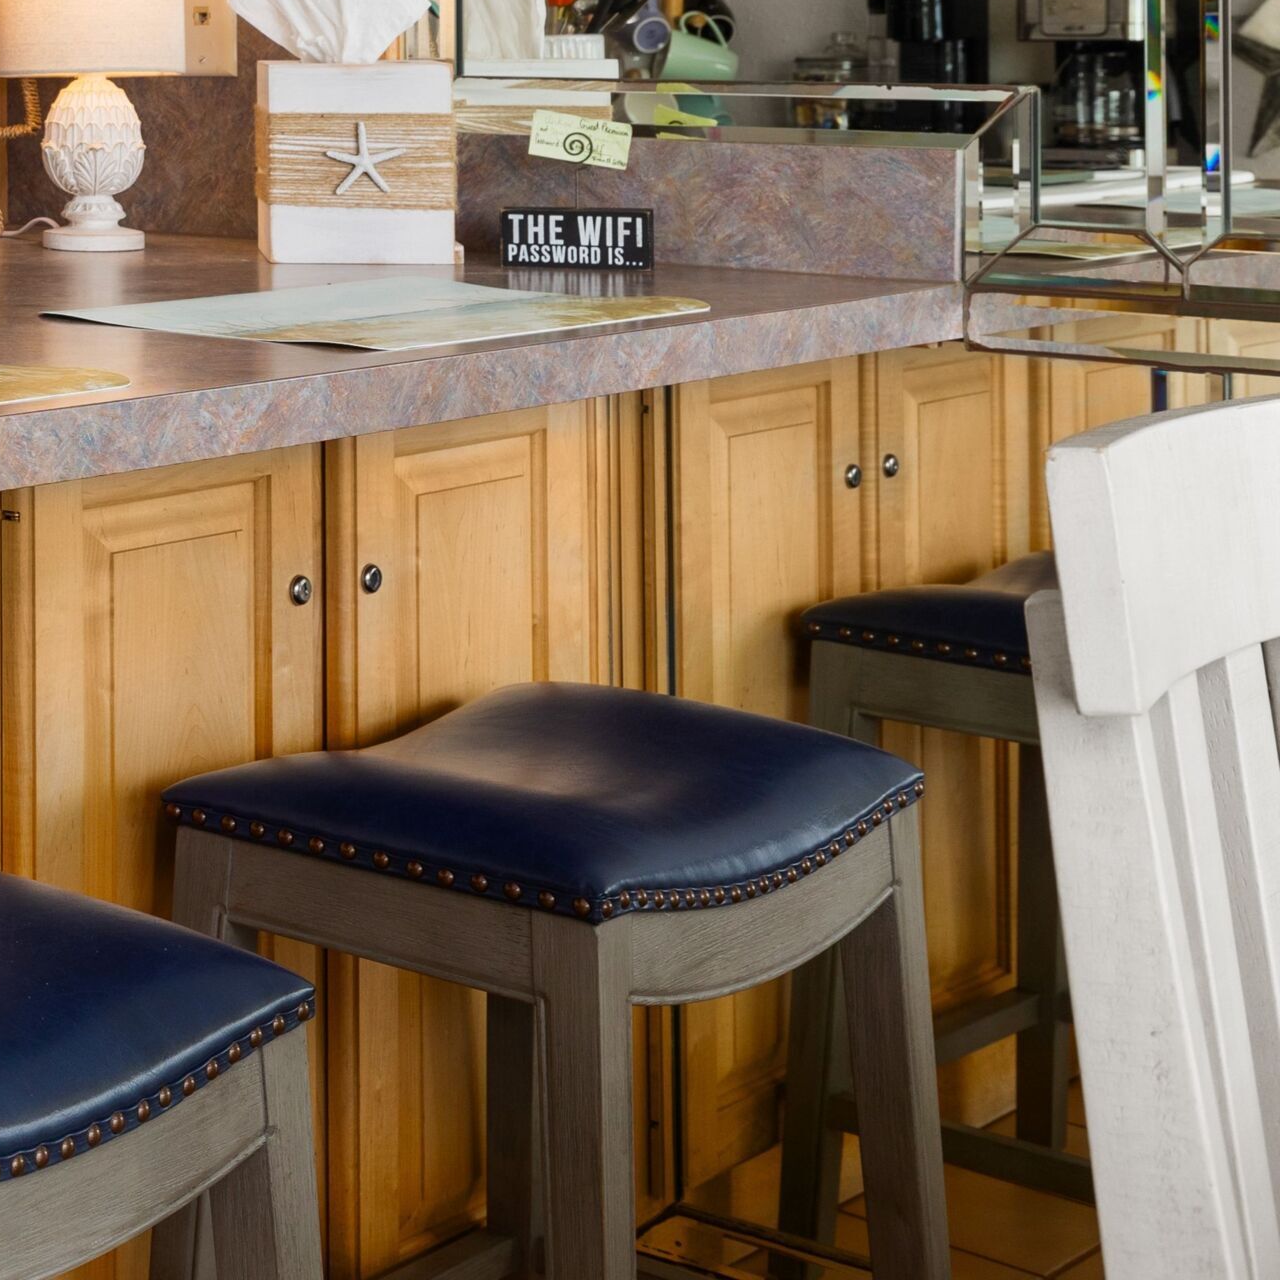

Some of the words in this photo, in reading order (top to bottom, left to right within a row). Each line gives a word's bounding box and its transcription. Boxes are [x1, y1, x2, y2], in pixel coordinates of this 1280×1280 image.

[507, 213, 565, 245] THE
[577, 215, 643, 248] WIFI
[507, 244, 601, 264] PASSWORD
[608, 247, 644, 266] IS...
